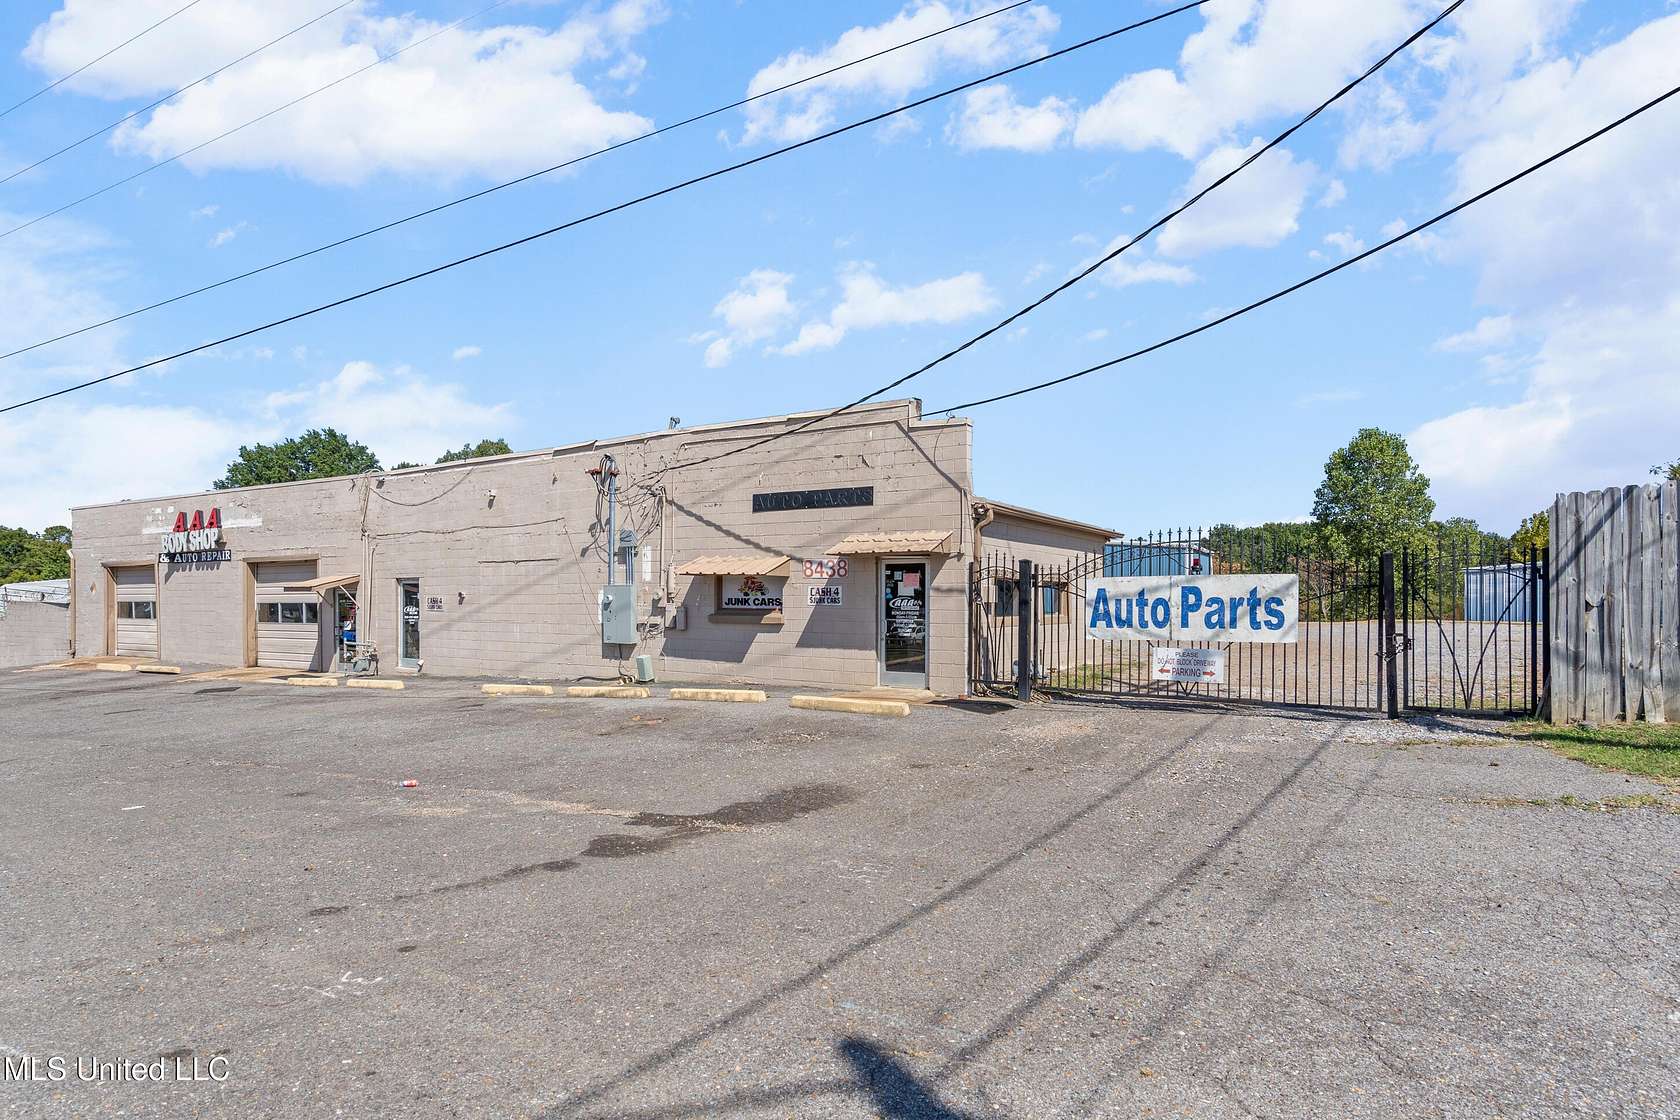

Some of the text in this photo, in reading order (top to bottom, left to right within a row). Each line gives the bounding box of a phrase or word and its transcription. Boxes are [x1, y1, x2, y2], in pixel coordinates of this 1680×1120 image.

[161, 528, 219, 554] BODY SHOP
[160, 550, 231, 563] & AUTO REPAIR
[804, 559, 848, 578] 8438
[810, 587, 840, 597] CASH 4
[724, 597, 782, 607] JUNK CARS
[1089, 585, 1286, 631] Auto Parts
[1176, 658, 1192, 666] BLOCK
[1171, 667, 1201, 678] PARKING
